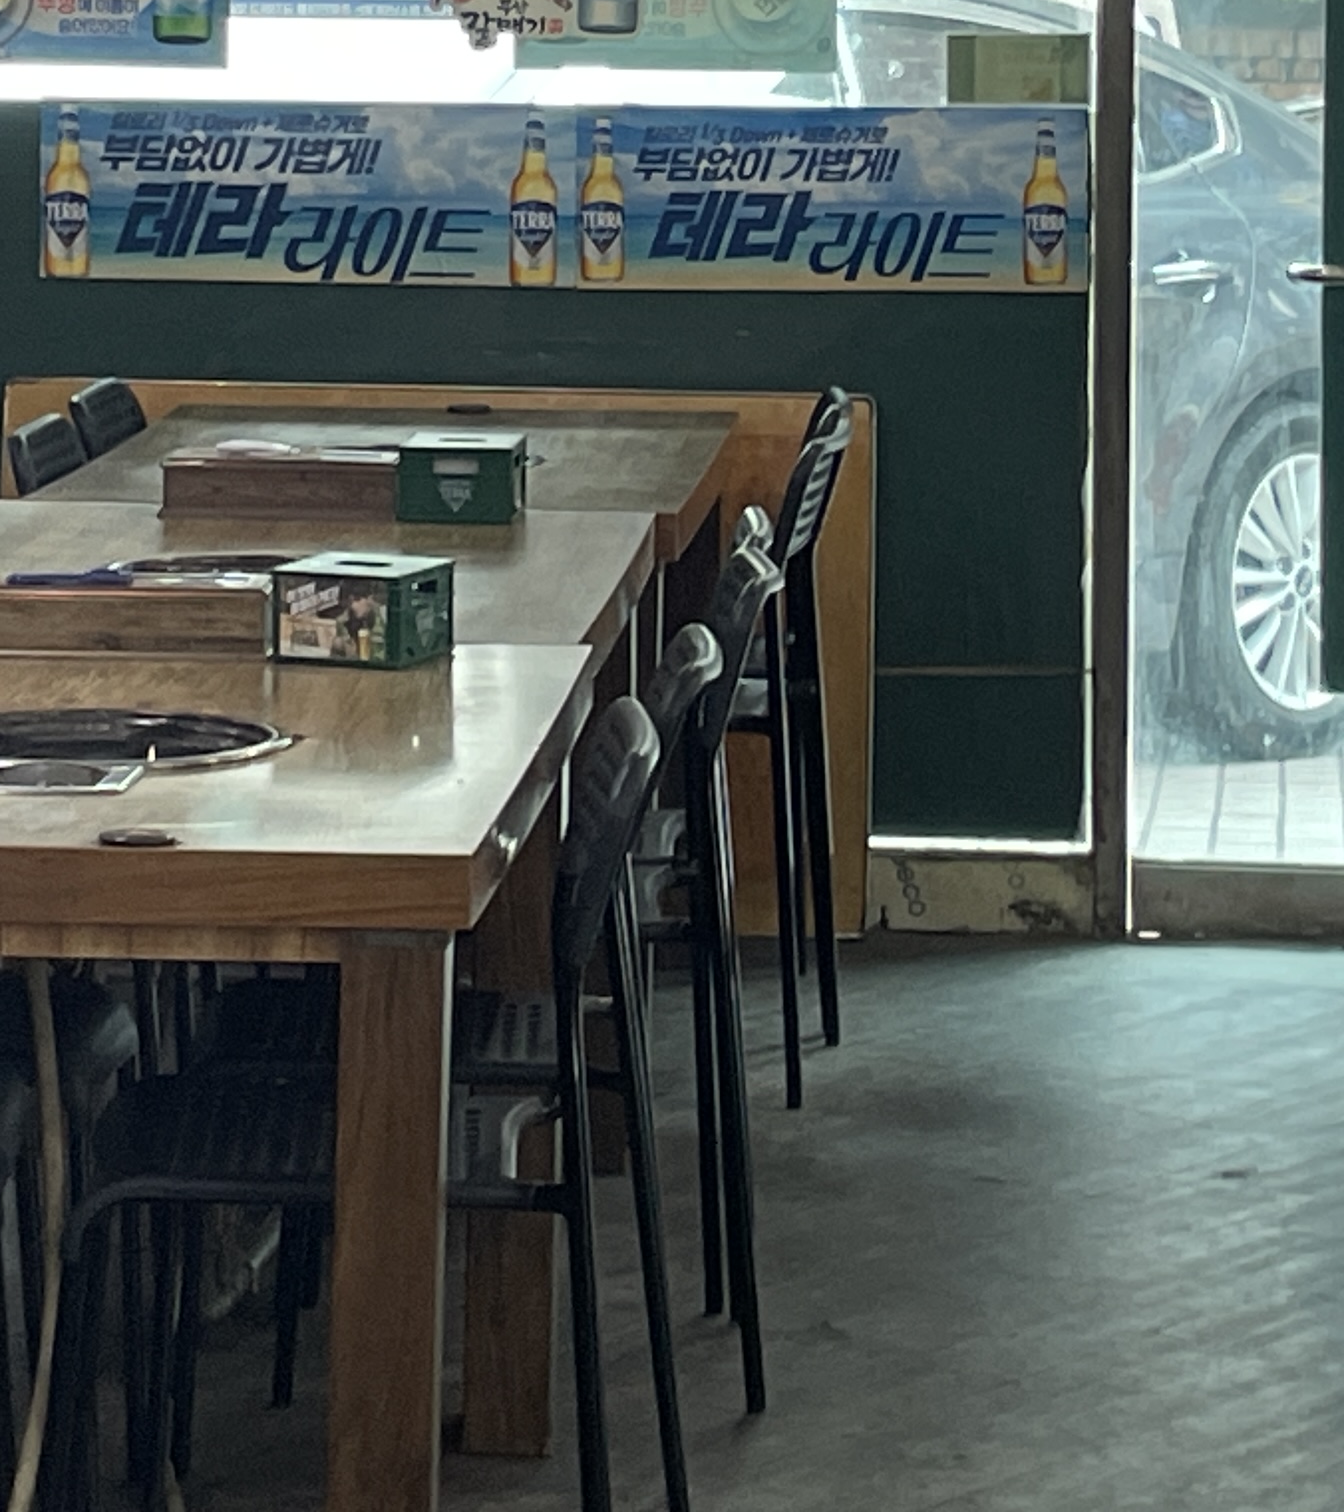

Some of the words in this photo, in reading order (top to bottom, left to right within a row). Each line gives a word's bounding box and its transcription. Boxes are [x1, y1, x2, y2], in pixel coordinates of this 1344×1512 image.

[99, 133, 252, 173] 부담없이
[253, 137, 383, 176] 가볍게!
[632, 145, 776, 183] 부담없이
[778, 146, 902, 184] 가볍게!
[114, 180, 294, 260] 테라
[283, 204, 492, 284] 라이트
[511, 208, 555, 230] TERRA
[582, 210, 623, 228] TERRA
[647, 189, 817, 263] 테라
[808, 210, 1006, 283] 라이트
